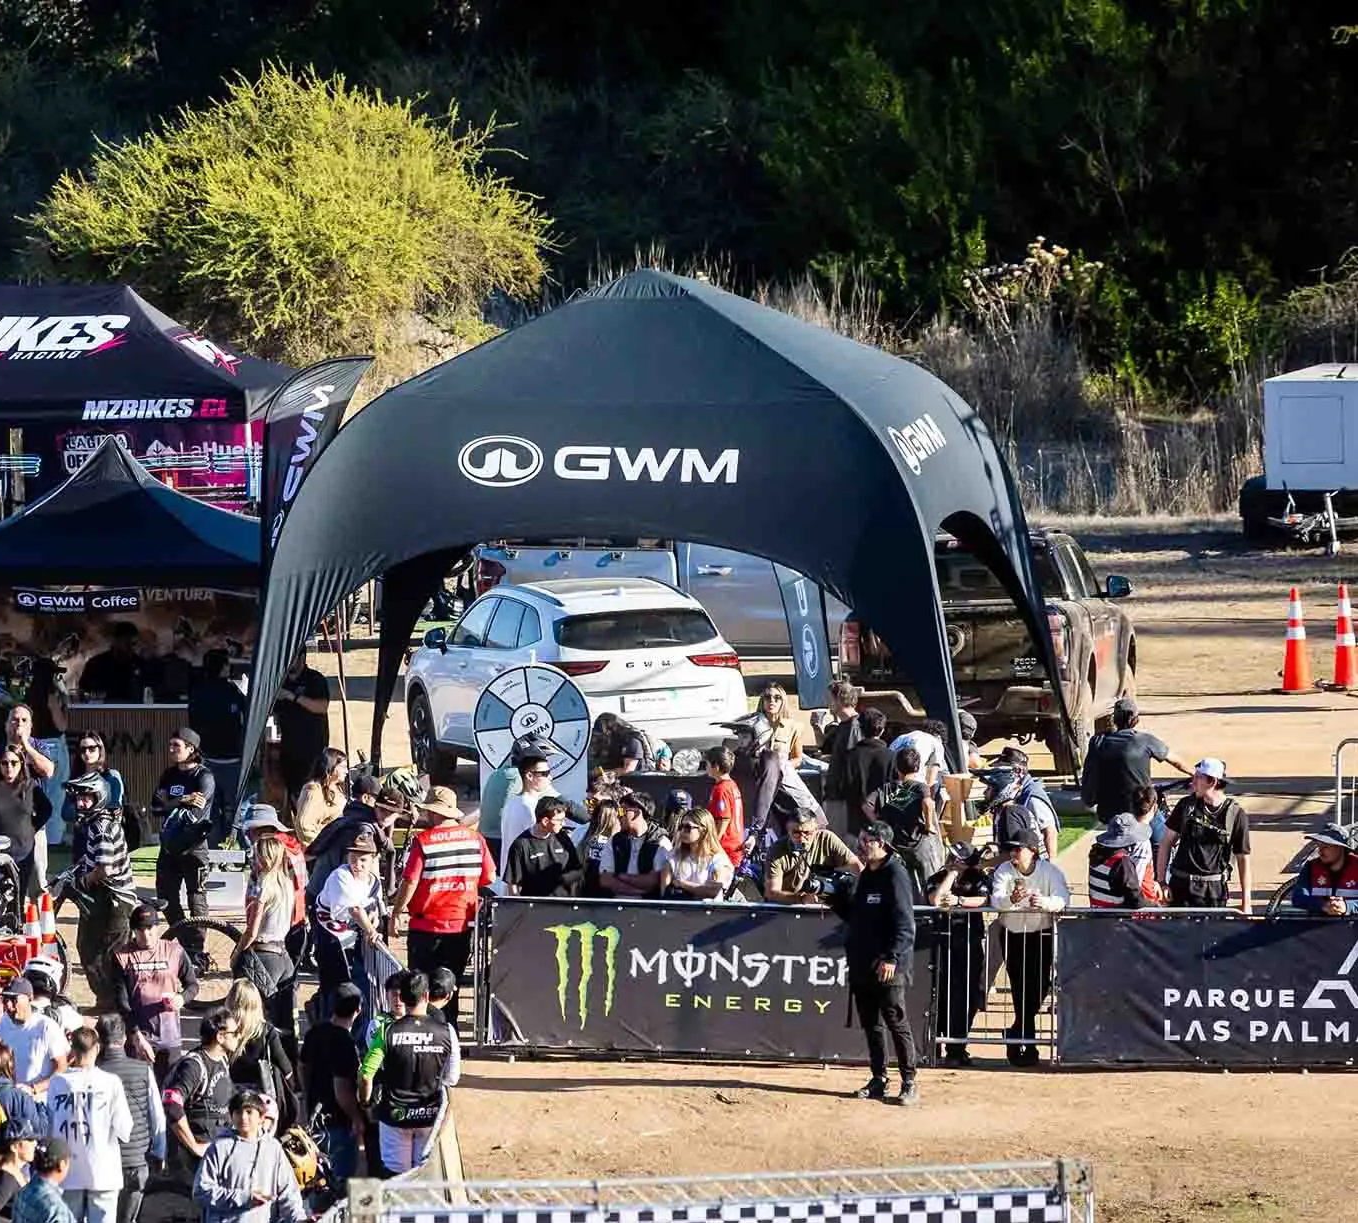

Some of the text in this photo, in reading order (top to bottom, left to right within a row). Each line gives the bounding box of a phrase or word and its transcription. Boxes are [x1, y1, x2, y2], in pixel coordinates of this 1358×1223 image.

[8, 351, 83, 361] RACING
[82, 398, 228, 421] MZBIKES.CL
[900, 413, 947, 462] GWM
[554, 446, 739, 484] GWM
[39, 595, 138, 608] GWM Coffee
[666, 994, 832, 1014] ENERGY
[1163, 988, 1295, 1011] PARQUE
[1163, 1020, 1358, 1042] LAS PALM
